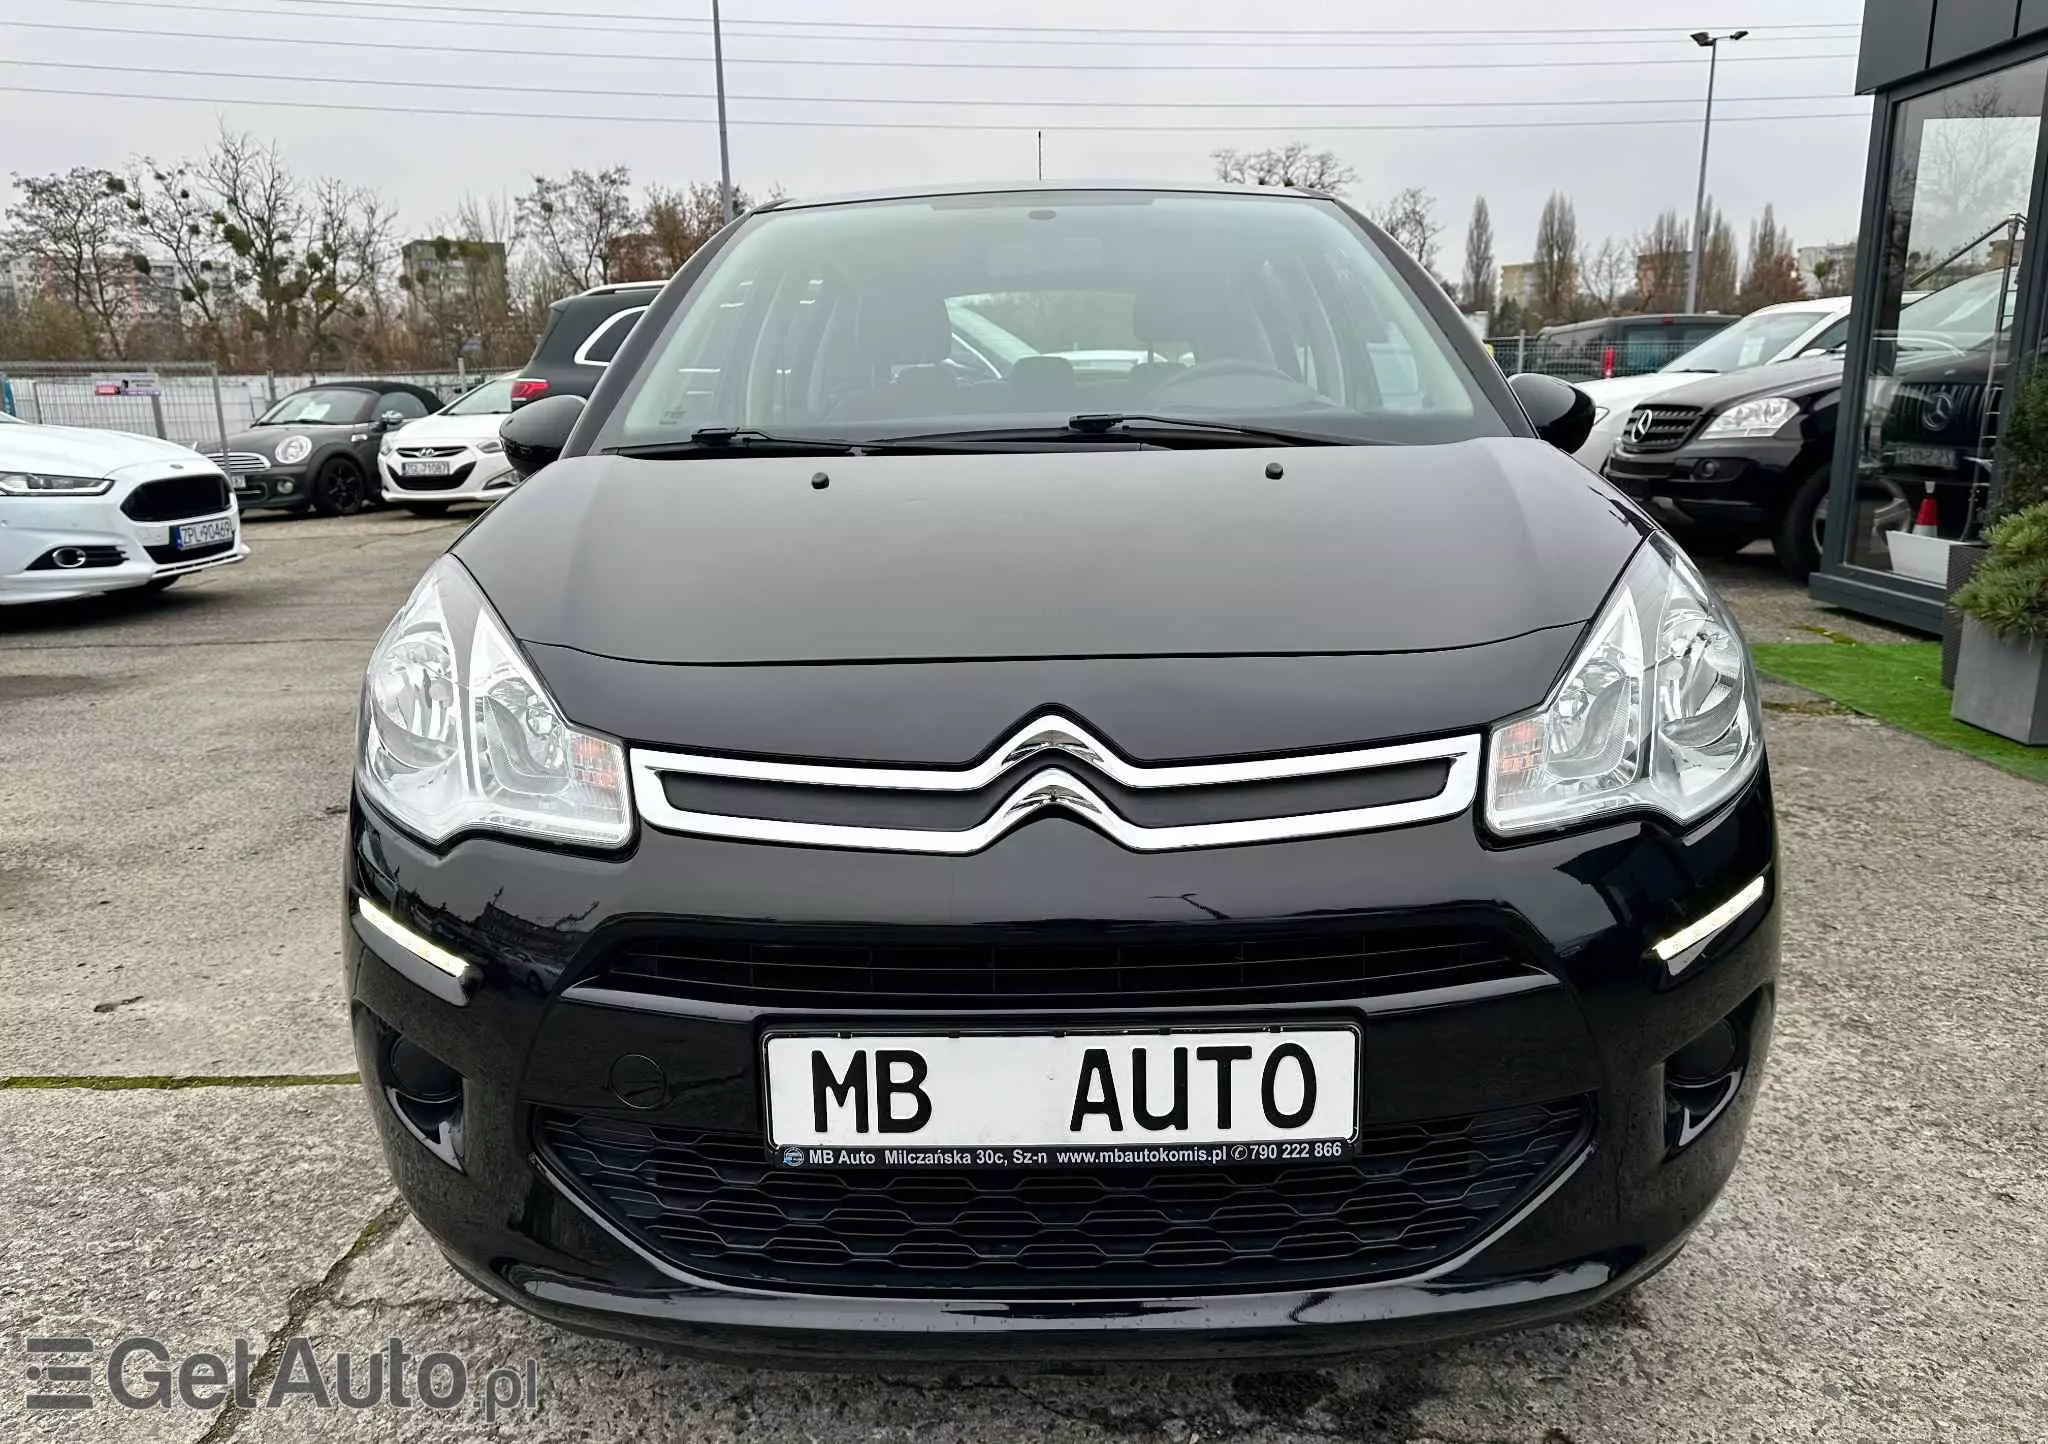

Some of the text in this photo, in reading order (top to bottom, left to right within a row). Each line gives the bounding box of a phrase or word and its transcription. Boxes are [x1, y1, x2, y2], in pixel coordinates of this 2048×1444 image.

[182, 526, 201, 545] ZPL
[811, 1042, 1318, 1134] MB AUTO
[808, 1141, 1342, 1167] MB Auto Milczańska 30c, Sz-n www.mbautokomis.pl 790 222 866
